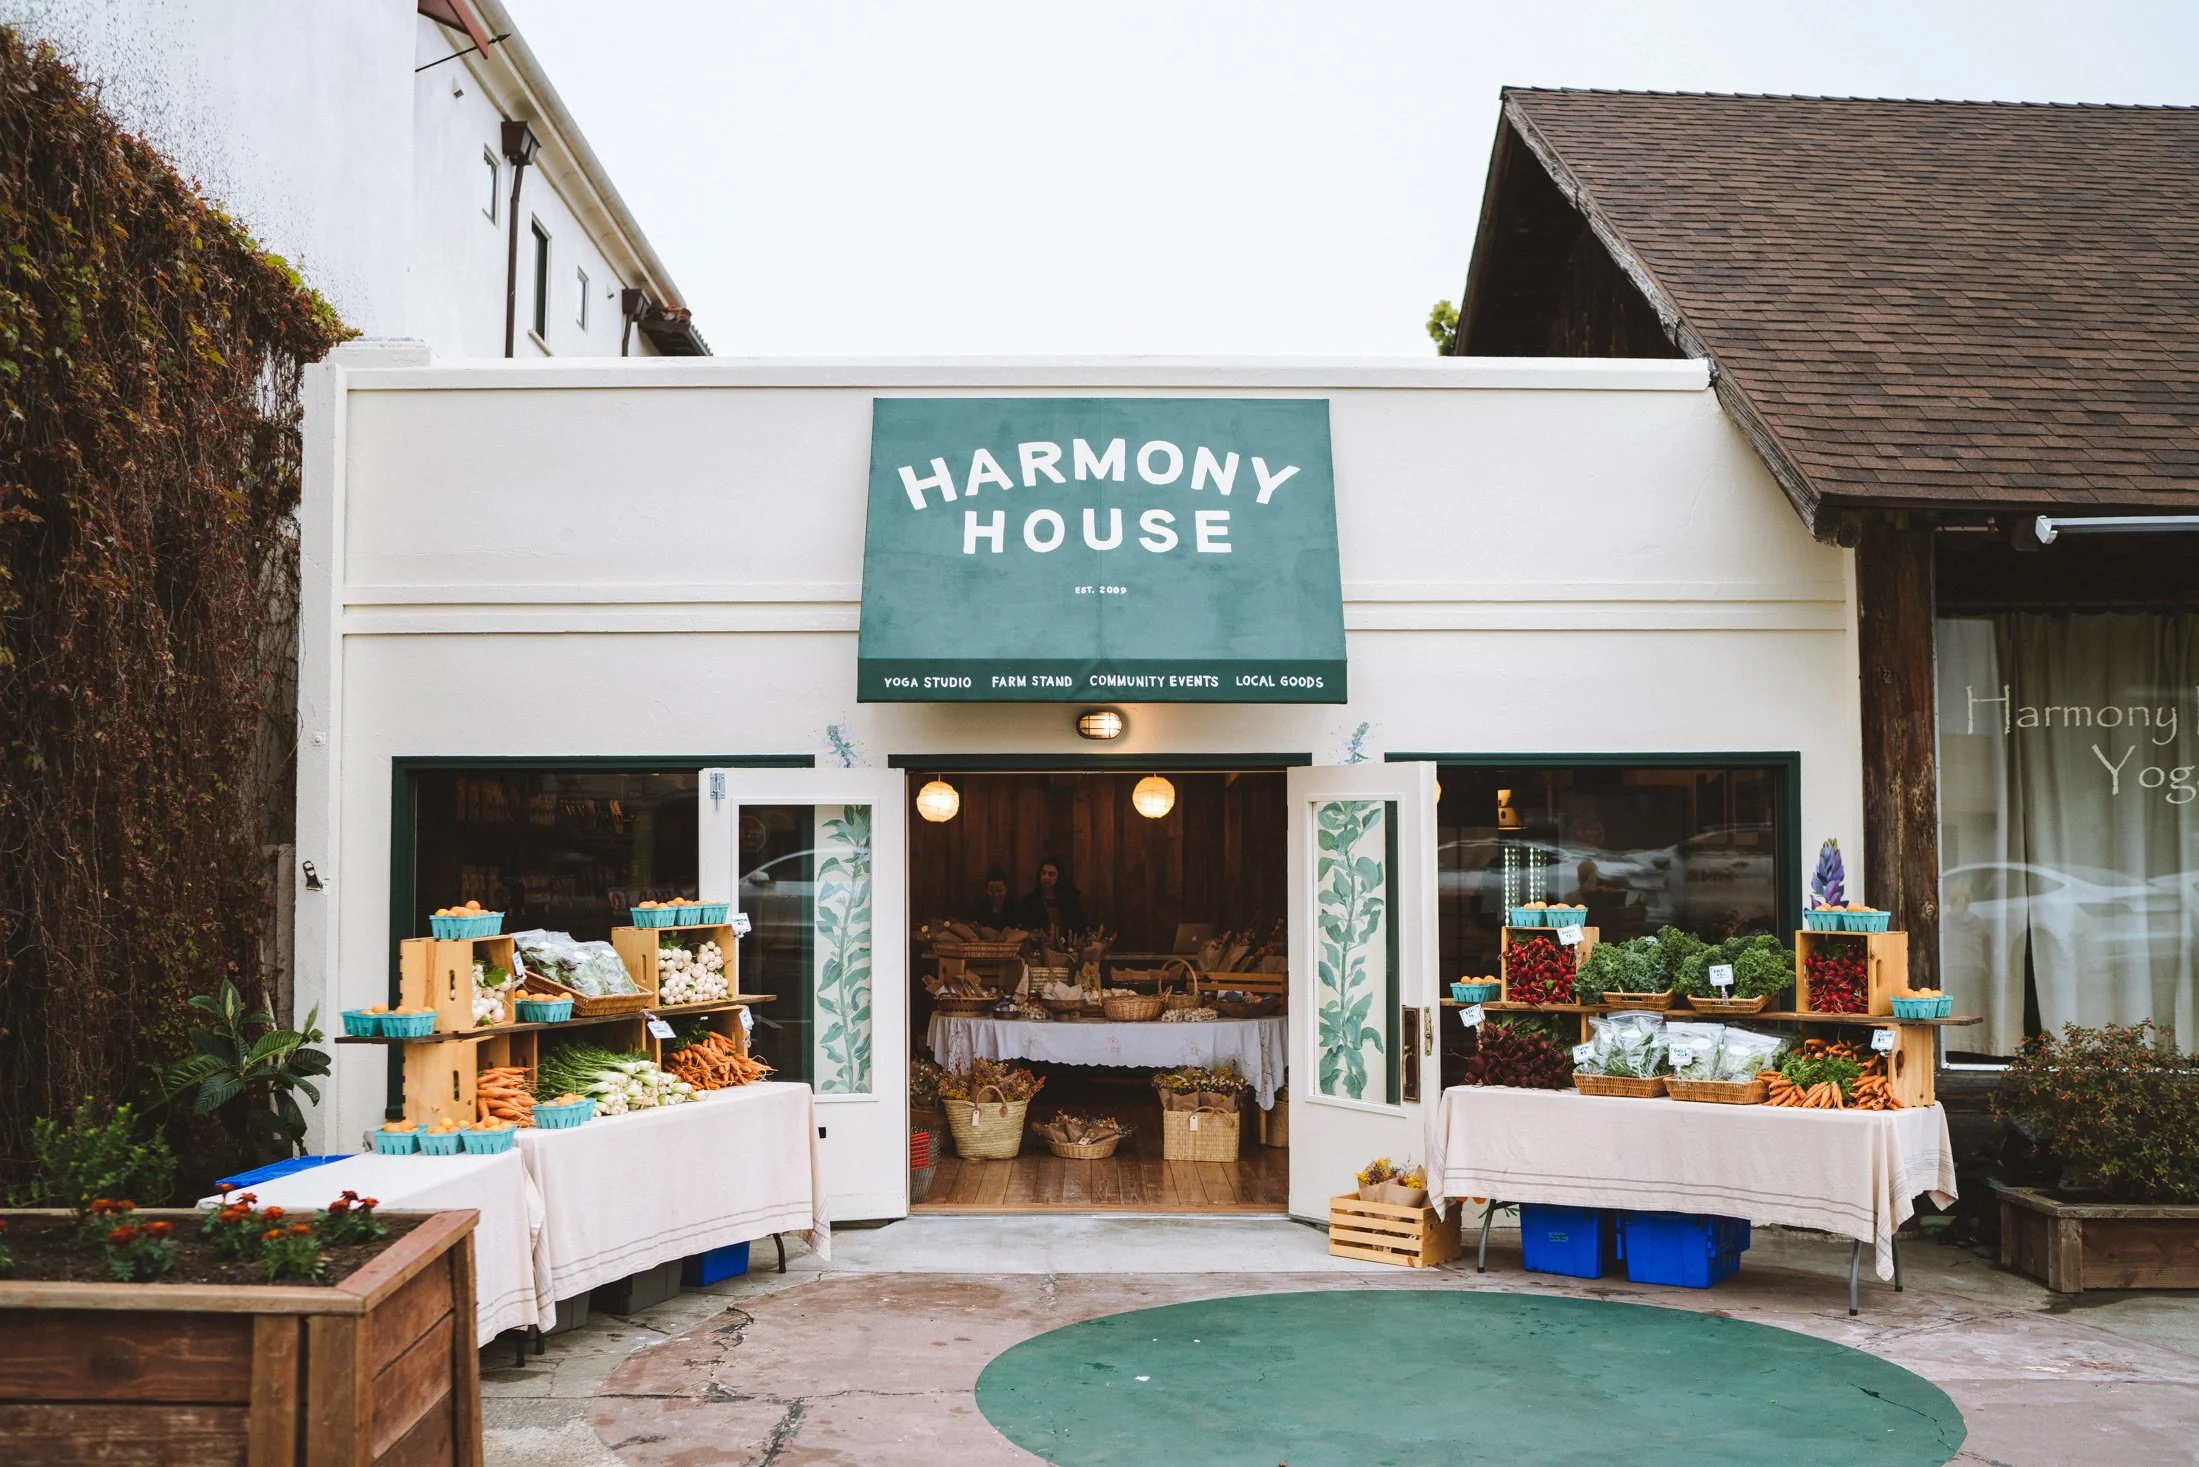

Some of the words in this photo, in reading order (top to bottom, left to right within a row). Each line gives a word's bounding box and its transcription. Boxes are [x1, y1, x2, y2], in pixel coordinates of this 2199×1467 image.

[898, 438, 1301, 511] HARMONY
[962, 508, 1232, 555] HOUSE
[1074, 585, 1095, 595] EST.
[1099, 585, 1128, 595] 2009
[884, 677, 919, 688] YOGA
[923, 676, 972, 689] STUDIO
[991, 675, 1027, 688] FARM
[1031, 675, 1073, 688] STAND
[1089, 674, 1166, 688] COMMUNITY
[1169, 674, 1219, 688] EVENTS
[1235, 675, 1276, 688] LOCAL
[1279, 675, 1324, 689] GOODS
[1966, 684, 2178, 746] Harmony
[2091, 744, 2199, 805] Yog
